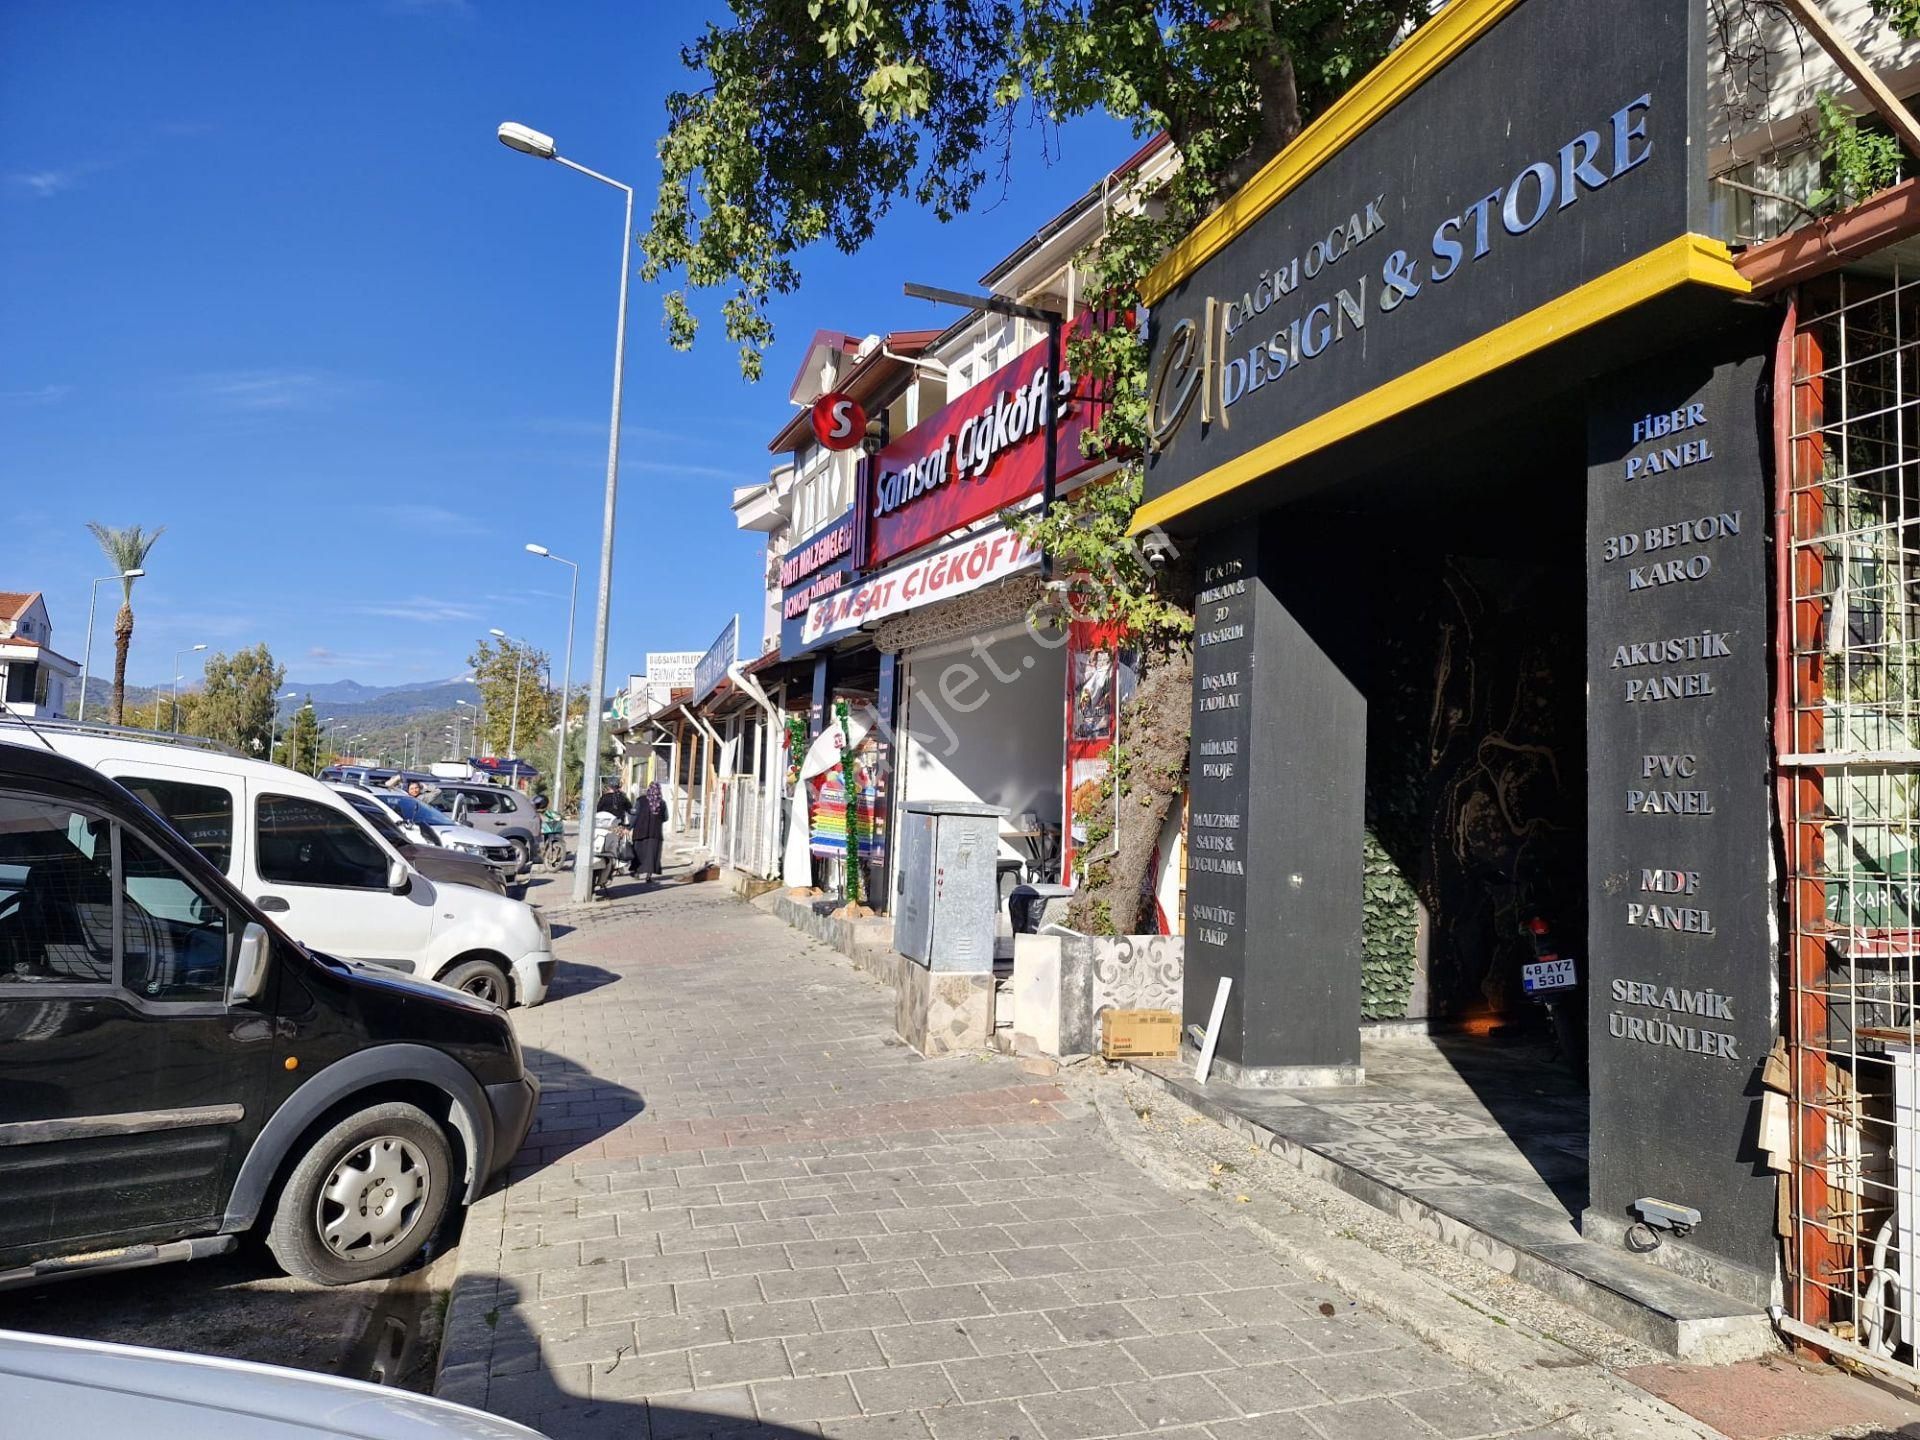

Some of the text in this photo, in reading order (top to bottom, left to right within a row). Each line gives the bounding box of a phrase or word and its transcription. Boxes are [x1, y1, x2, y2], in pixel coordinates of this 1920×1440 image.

[1223, 93, 1653, 407] DESIGN & STORE
[1225, 194, 1386, 340] ÇAĞRI OCAK
[1633, 403, 1708, 443] FİBER
[1625, 439, 1714, 481] PANEL
[874, 437, 951, 518] Samsat
[1604, 510, 1742, 562] 3D BETON
[1629, 555, 1711, 591] KARO
[812, 580, 896, 632] SAMSAT
[1201, 579, 1246, 605] MEKAN &
[1215, 606, 1230, 623] 3D
[1200, 624, 1243, 647] TASARIM
[1610, 629, 1732, 669] AKUSTİK
[1625, 673, 1715, 702] PANEL
[1203, 763, 1234, 781] PROJE
[1643, 755, 1697, 778] PVC
[1626, 790, 1715, 815] PANEL
[1193, 813, 1240, 829] MALZEME
[1188, 858, 1244, 876] UYGULAMA
[1640, 868, 1700, 895] MDF
[1627, 903, 1716, 935] PANEL
[1199, 926, 1228, 947] TAKİP
[1539, 974, 1565, 986] 530
[1547, 961, 1572, 973] AYZ
[1612, 979, 1735, 1020] SERAMİK
[1609, 1010, 1741, 1060] ÜRÜNLER
